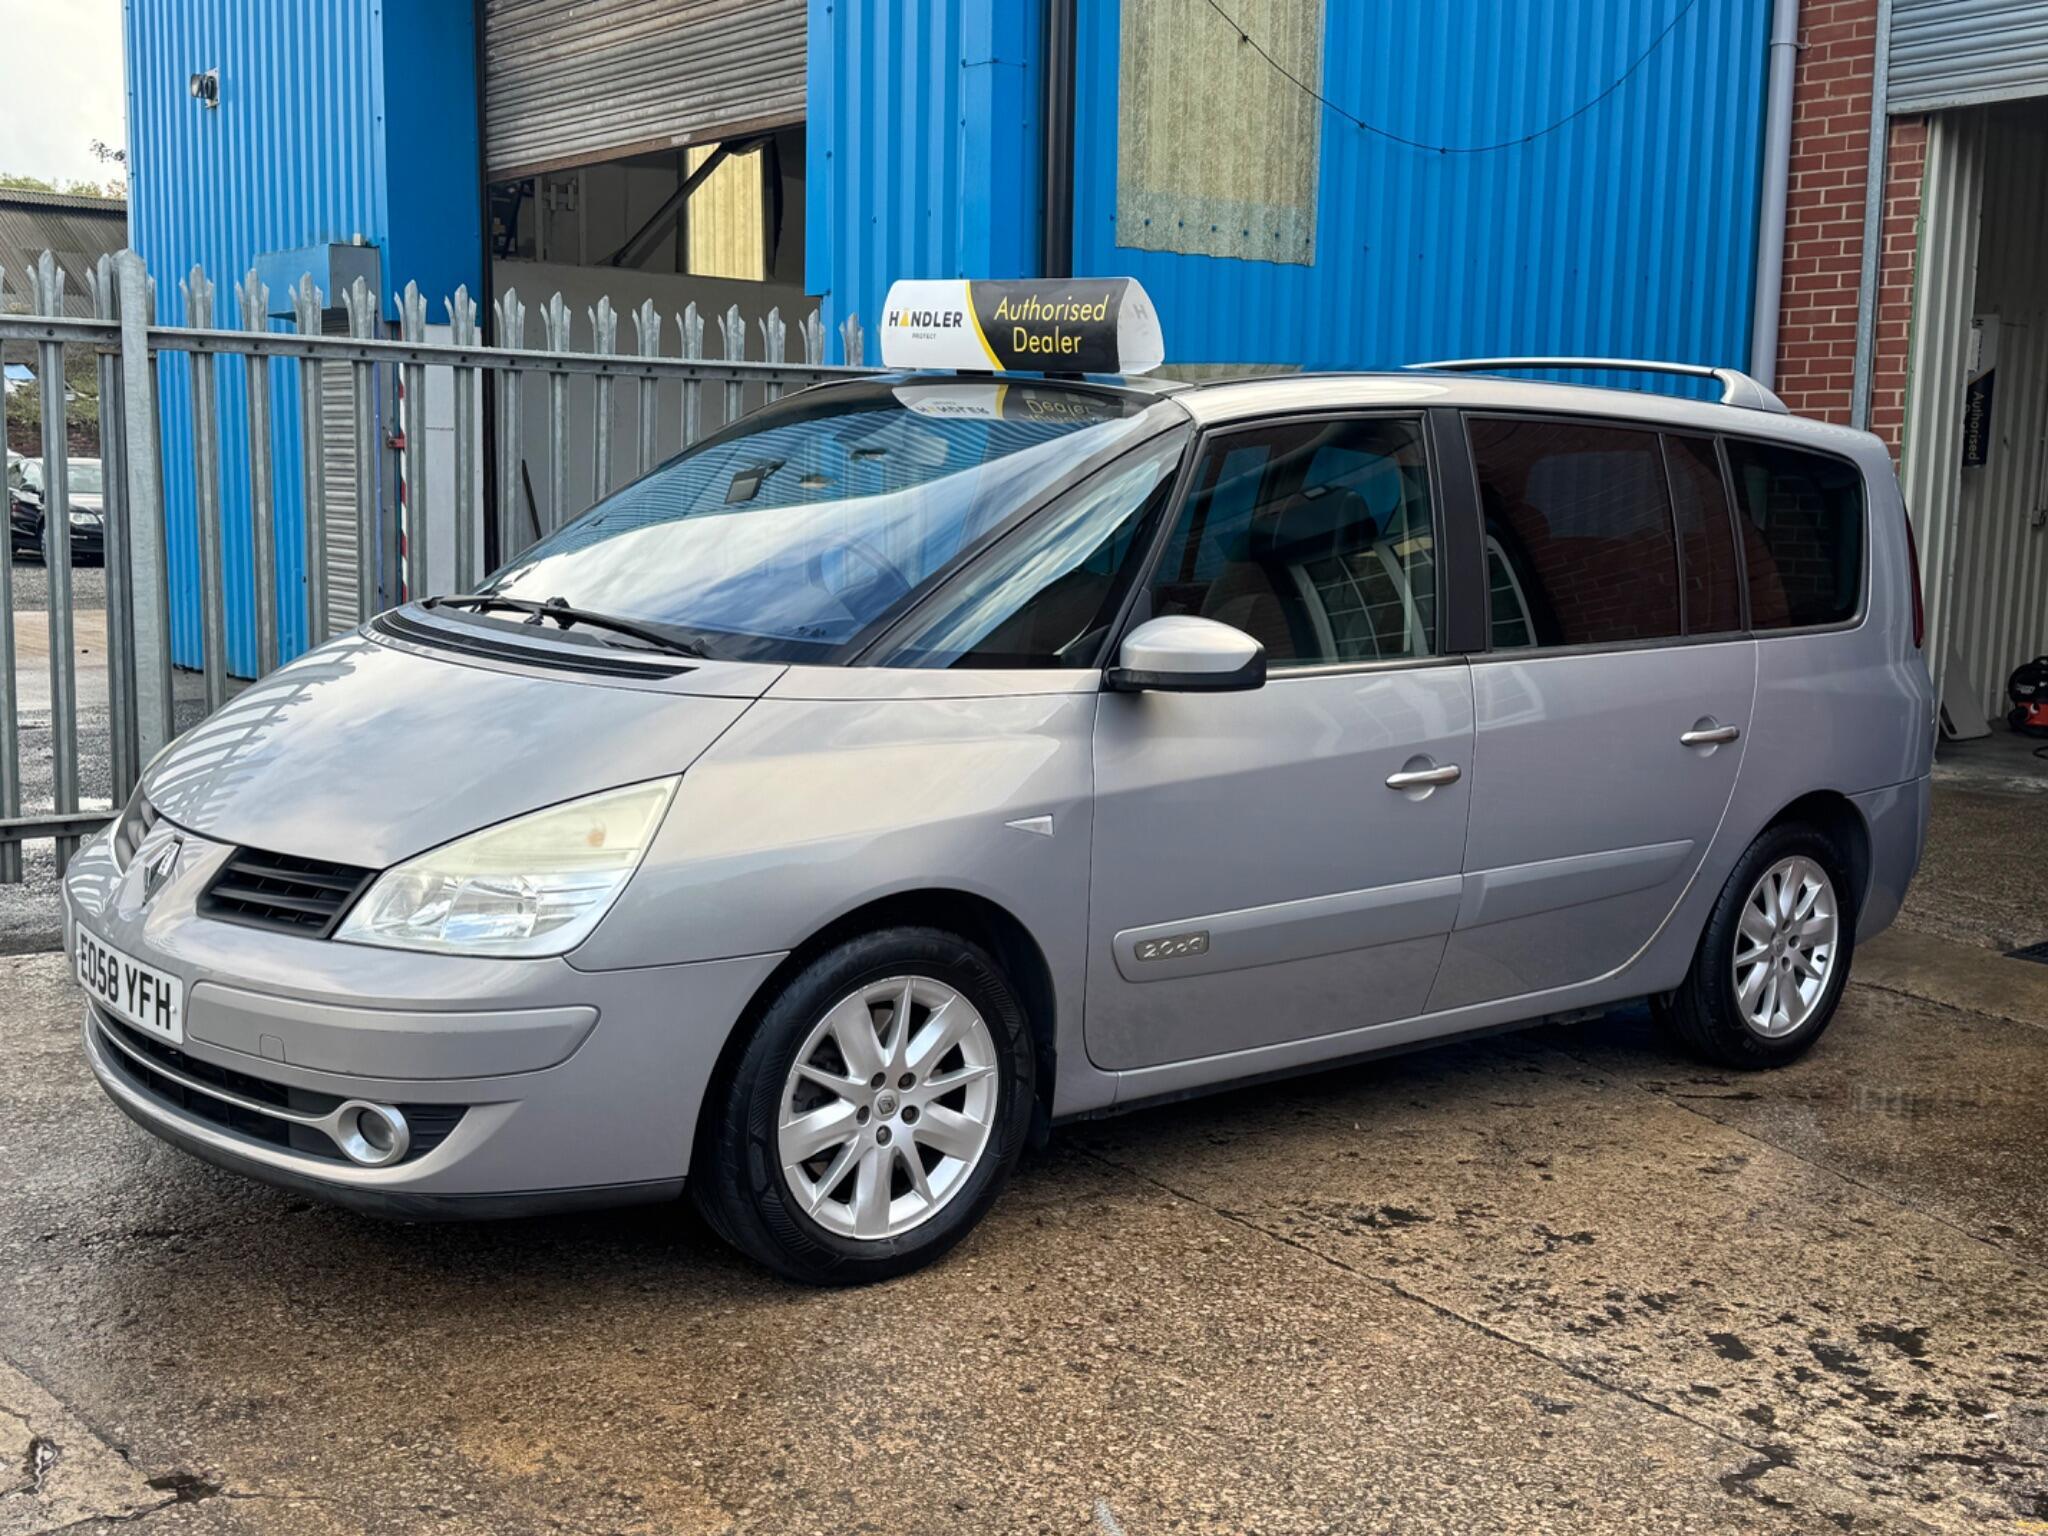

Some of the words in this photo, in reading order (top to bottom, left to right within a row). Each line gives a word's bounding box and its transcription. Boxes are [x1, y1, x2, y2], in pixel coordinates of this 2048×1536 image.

[888, 309, 963, 328] HANDLER
[994, 294, 1109, 322] Authorised
[1013, 327, 1082, 354] Dealer
[1968, 391, 1985, 461] Authorised
[124, 963, 171, 1031] YFH
